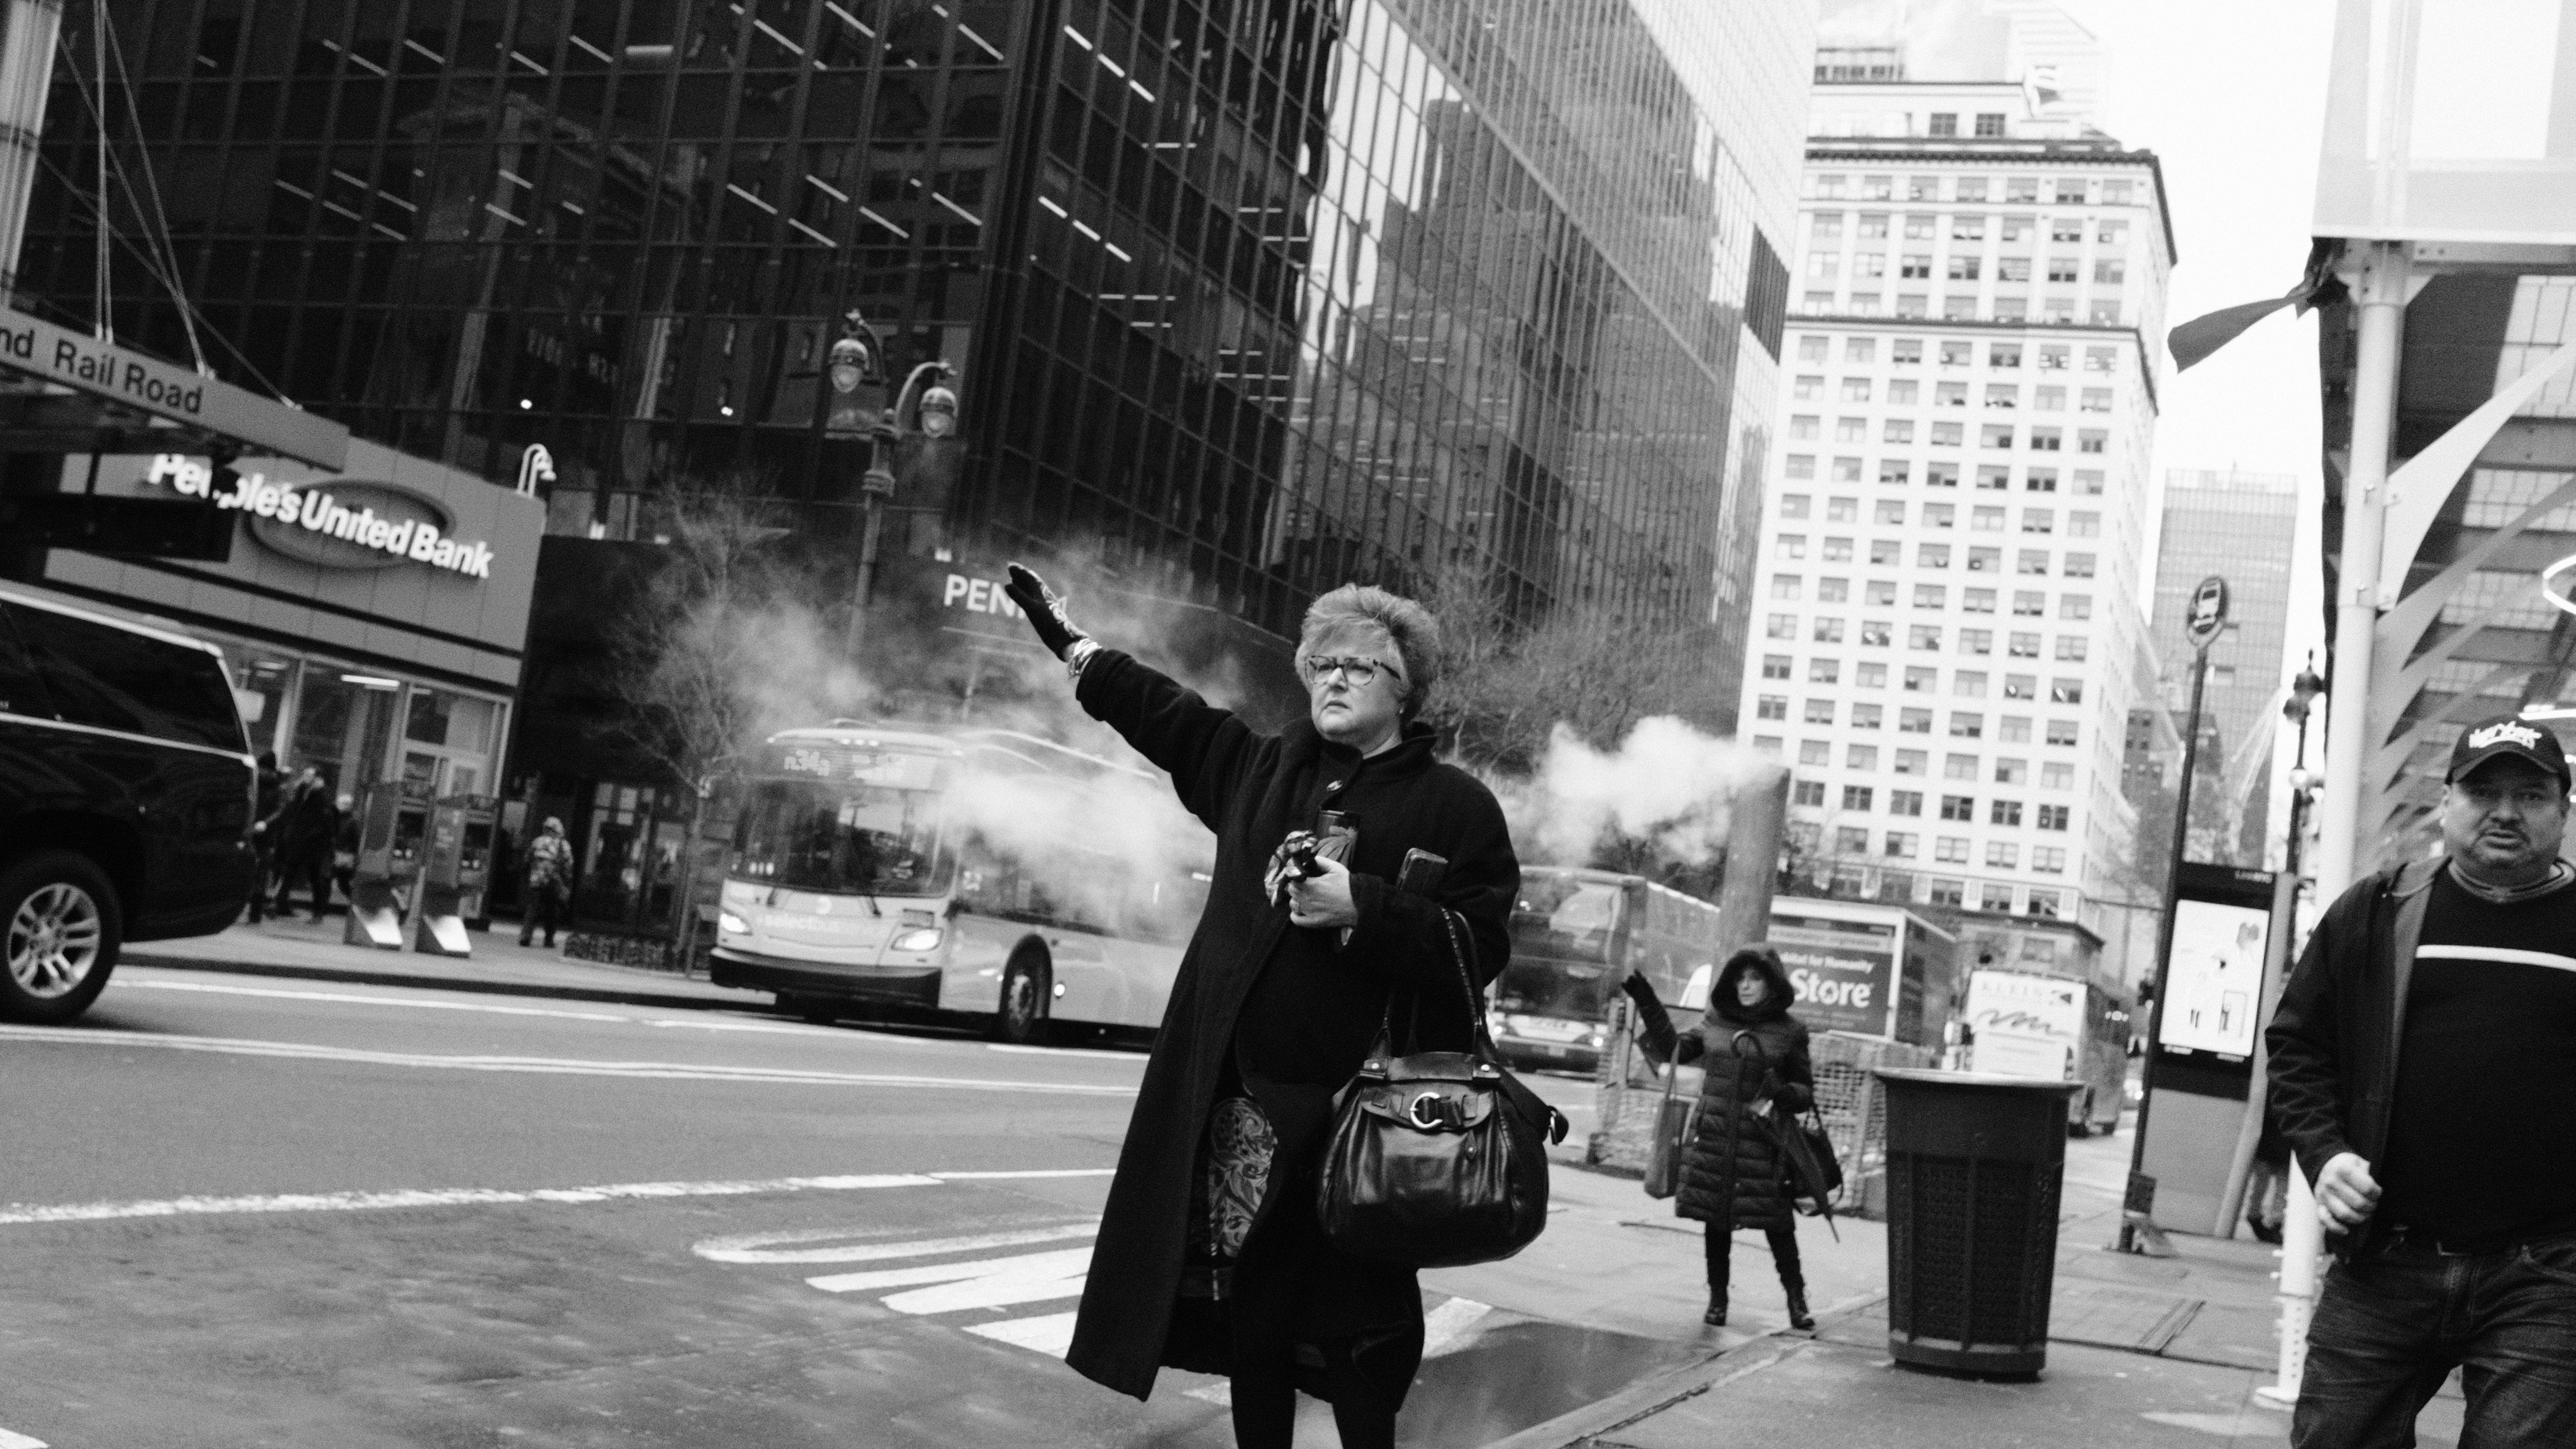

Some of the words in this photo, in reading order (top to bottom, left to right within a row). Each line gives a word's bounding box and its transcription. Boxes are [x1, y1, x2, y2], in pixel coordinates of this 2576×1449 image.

[55, 339, 115, 386] Rail
[124, 363, 203, 415] Road
[300, 490, 413, 555] United
[409, 523, 495, 579] Bank
